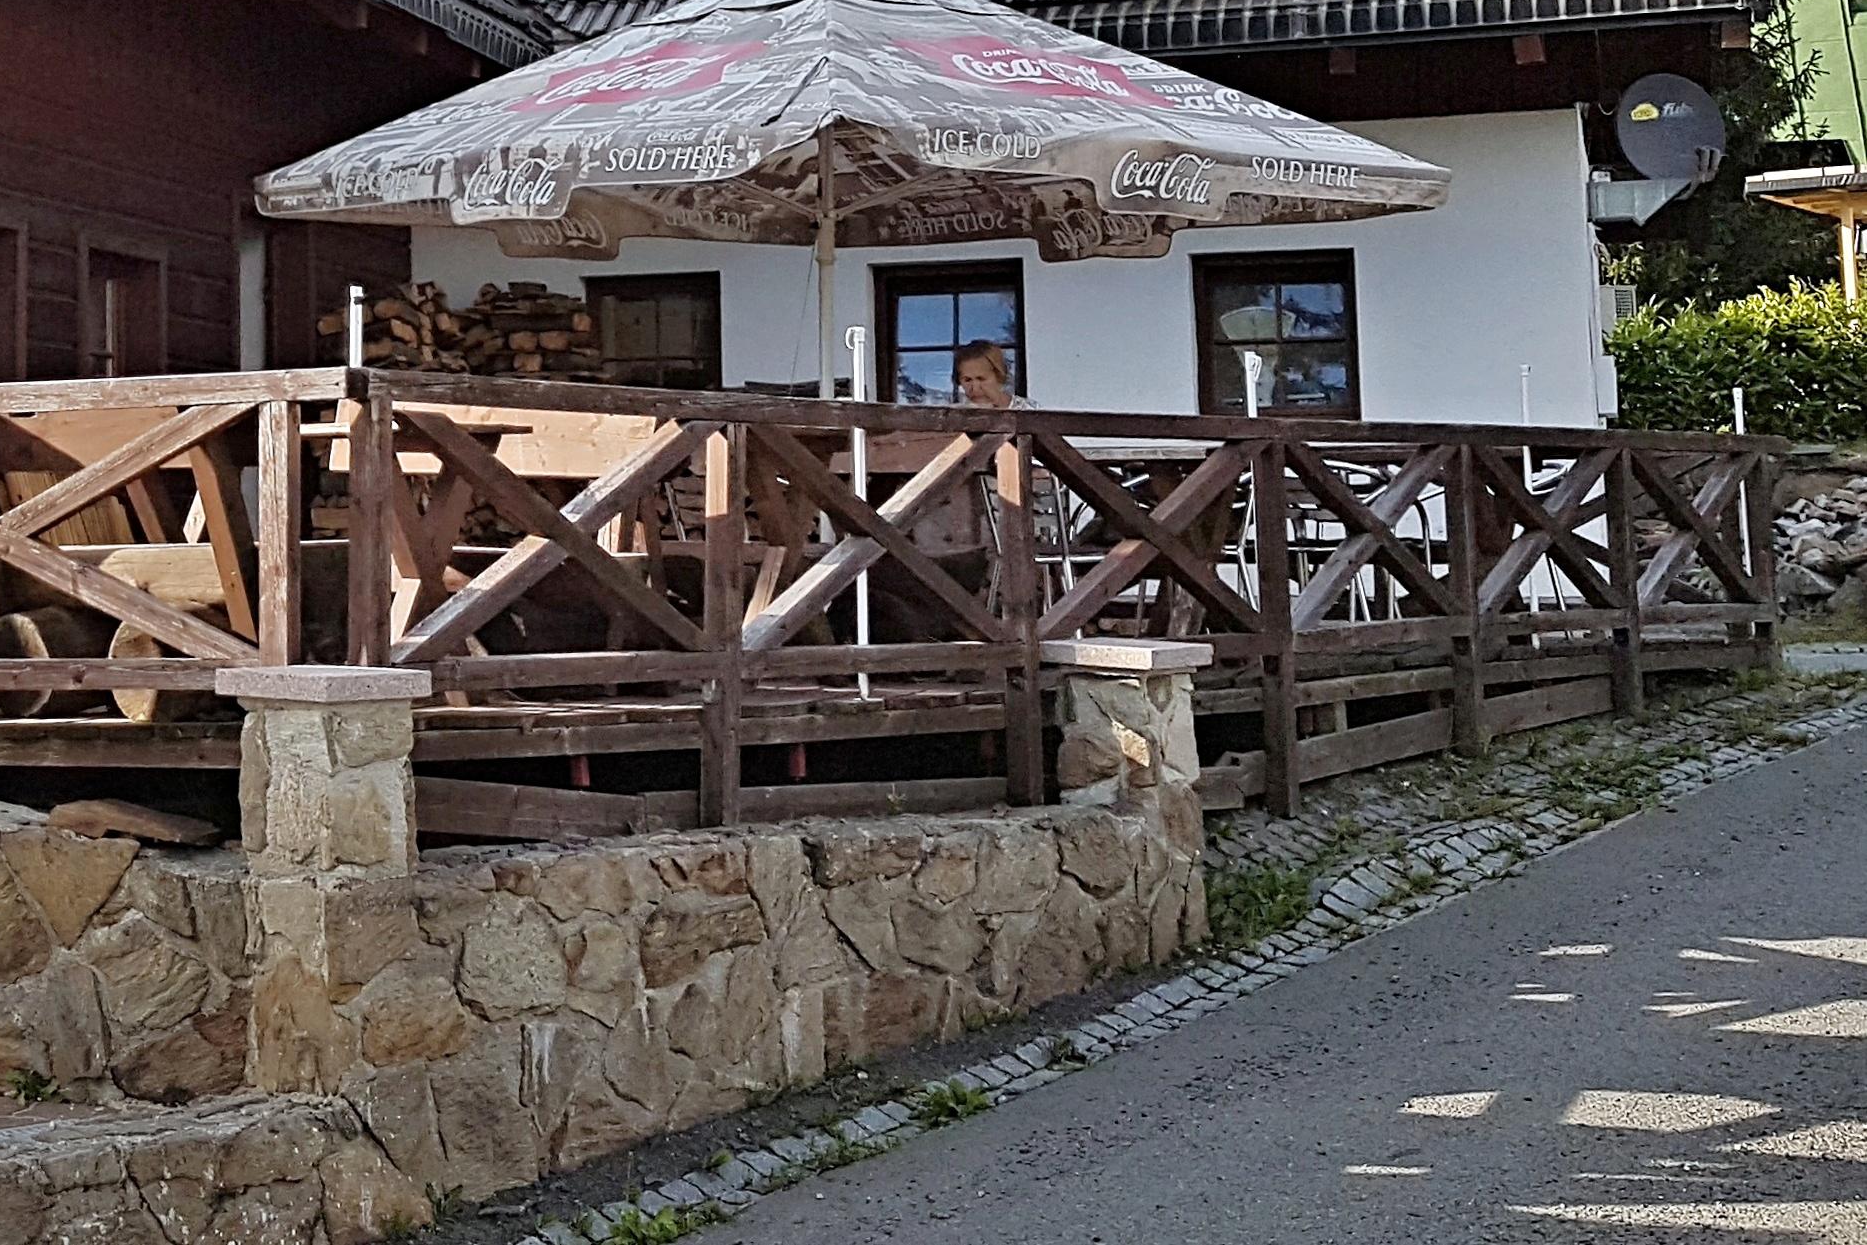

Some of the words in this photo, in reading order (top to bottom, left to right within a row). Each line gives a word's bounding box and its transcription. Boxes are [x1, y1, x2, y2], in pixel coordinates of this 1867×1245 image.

[952, 55, 1130, 97] Coca-Cola
[605, 147, 666, 172] SOLD
[671, 144, 735, 170] HERE
[934, 128, 970, 155] ICE
[976, 132, 1042, 158] COLD
[464, 158, 564, 211] Coca-Cola
[1110, 149, 1217, 204] Coca-Cola
[1250, 156, 1303, 183] SOLD
[1309, 163, 1360, 188] HERE
